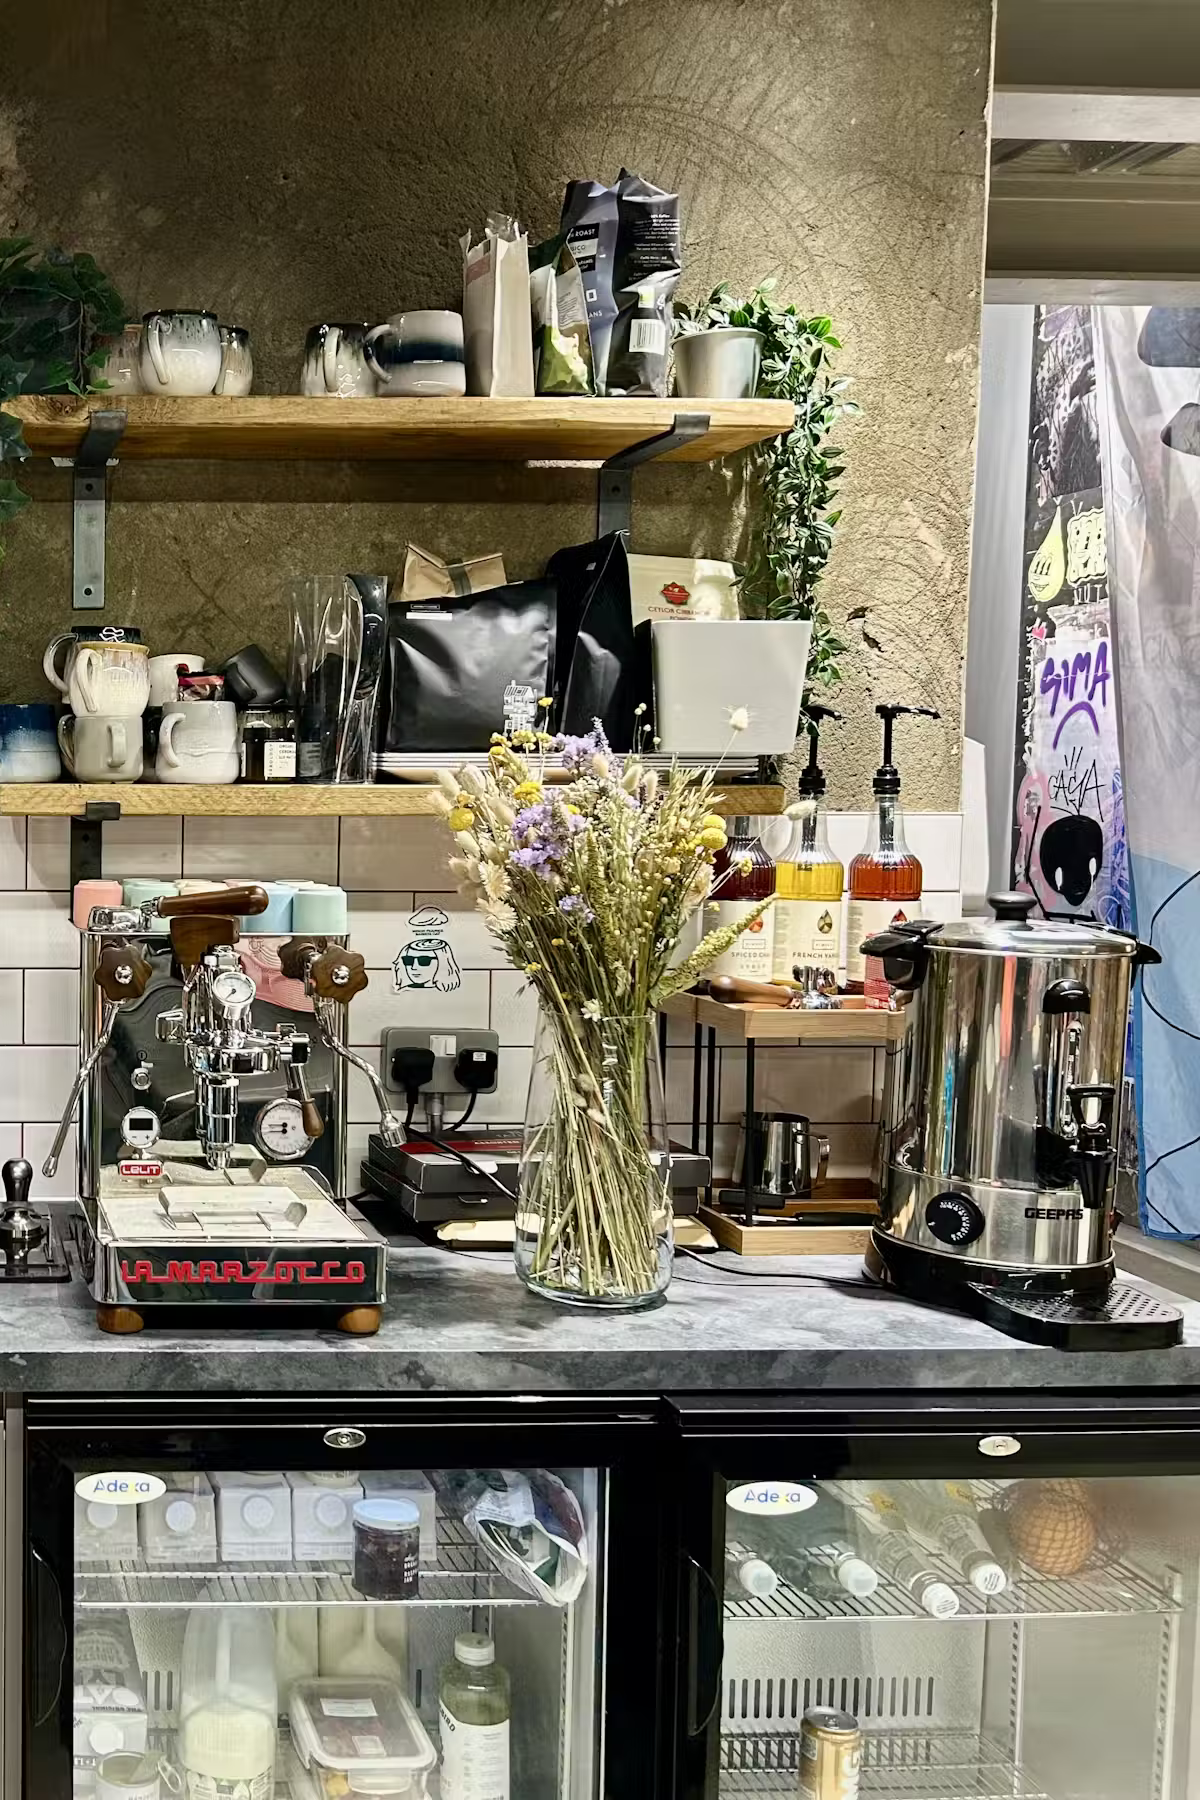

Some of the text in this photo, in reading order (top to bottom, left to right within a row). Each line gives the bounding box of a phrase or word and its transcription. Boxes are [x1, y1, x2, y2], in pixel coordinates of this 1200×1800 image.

[575, 228, 596, 237] ROAST
[1025, 1208, 1084, 1221] GEEPAS
[121, 1260, 152, 1283] LA
